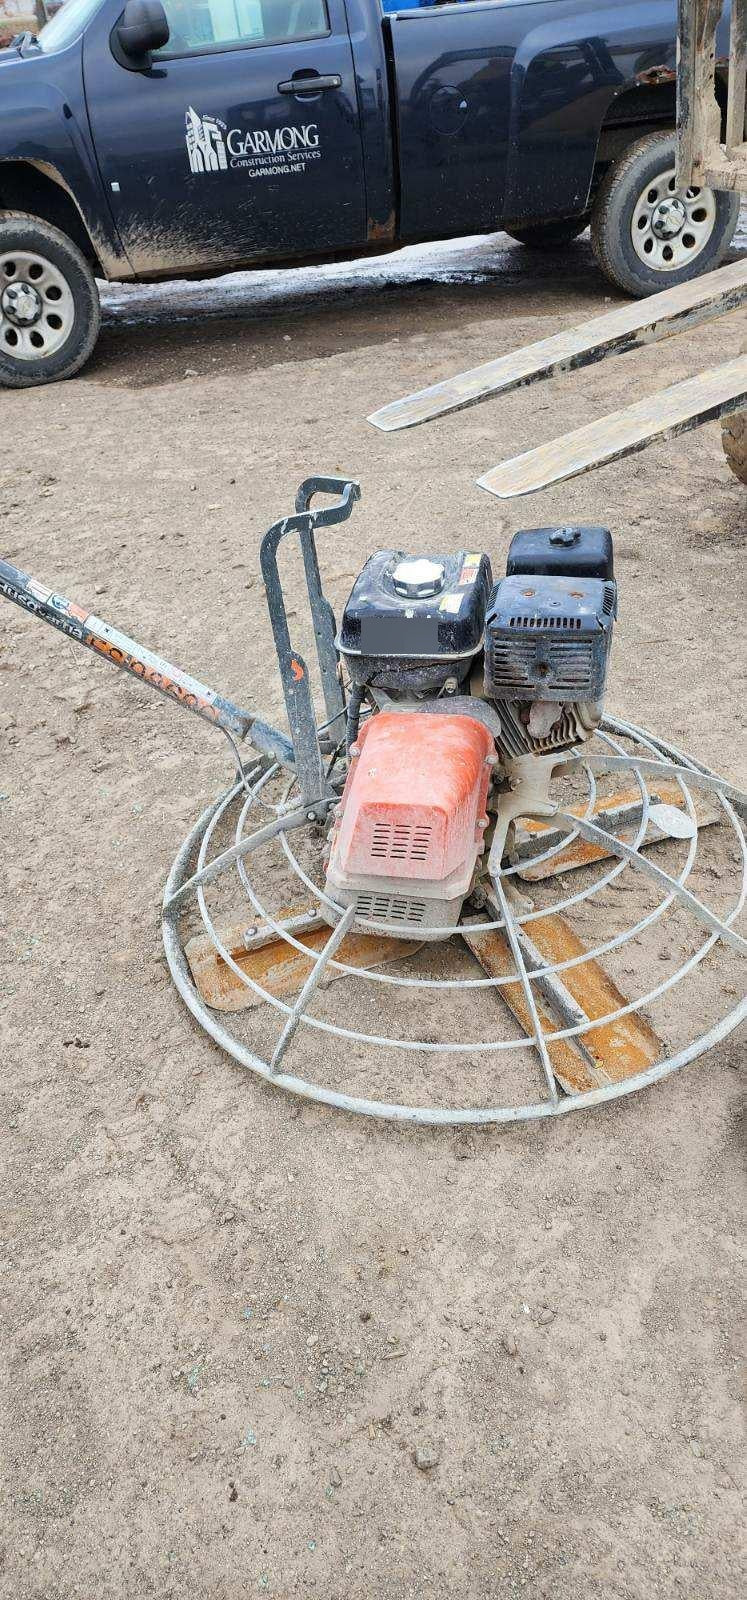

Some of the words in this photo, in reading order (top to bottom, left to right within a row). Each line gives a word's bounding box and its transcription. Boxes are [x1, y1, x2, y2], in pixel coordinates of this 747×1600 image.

[226, 124, 319, 156] GARMONG
[230, 154, 285, 168] Construction
[287, 150, 321, 162] Services
[248, 163, 307, 178] GARMONG.NET
